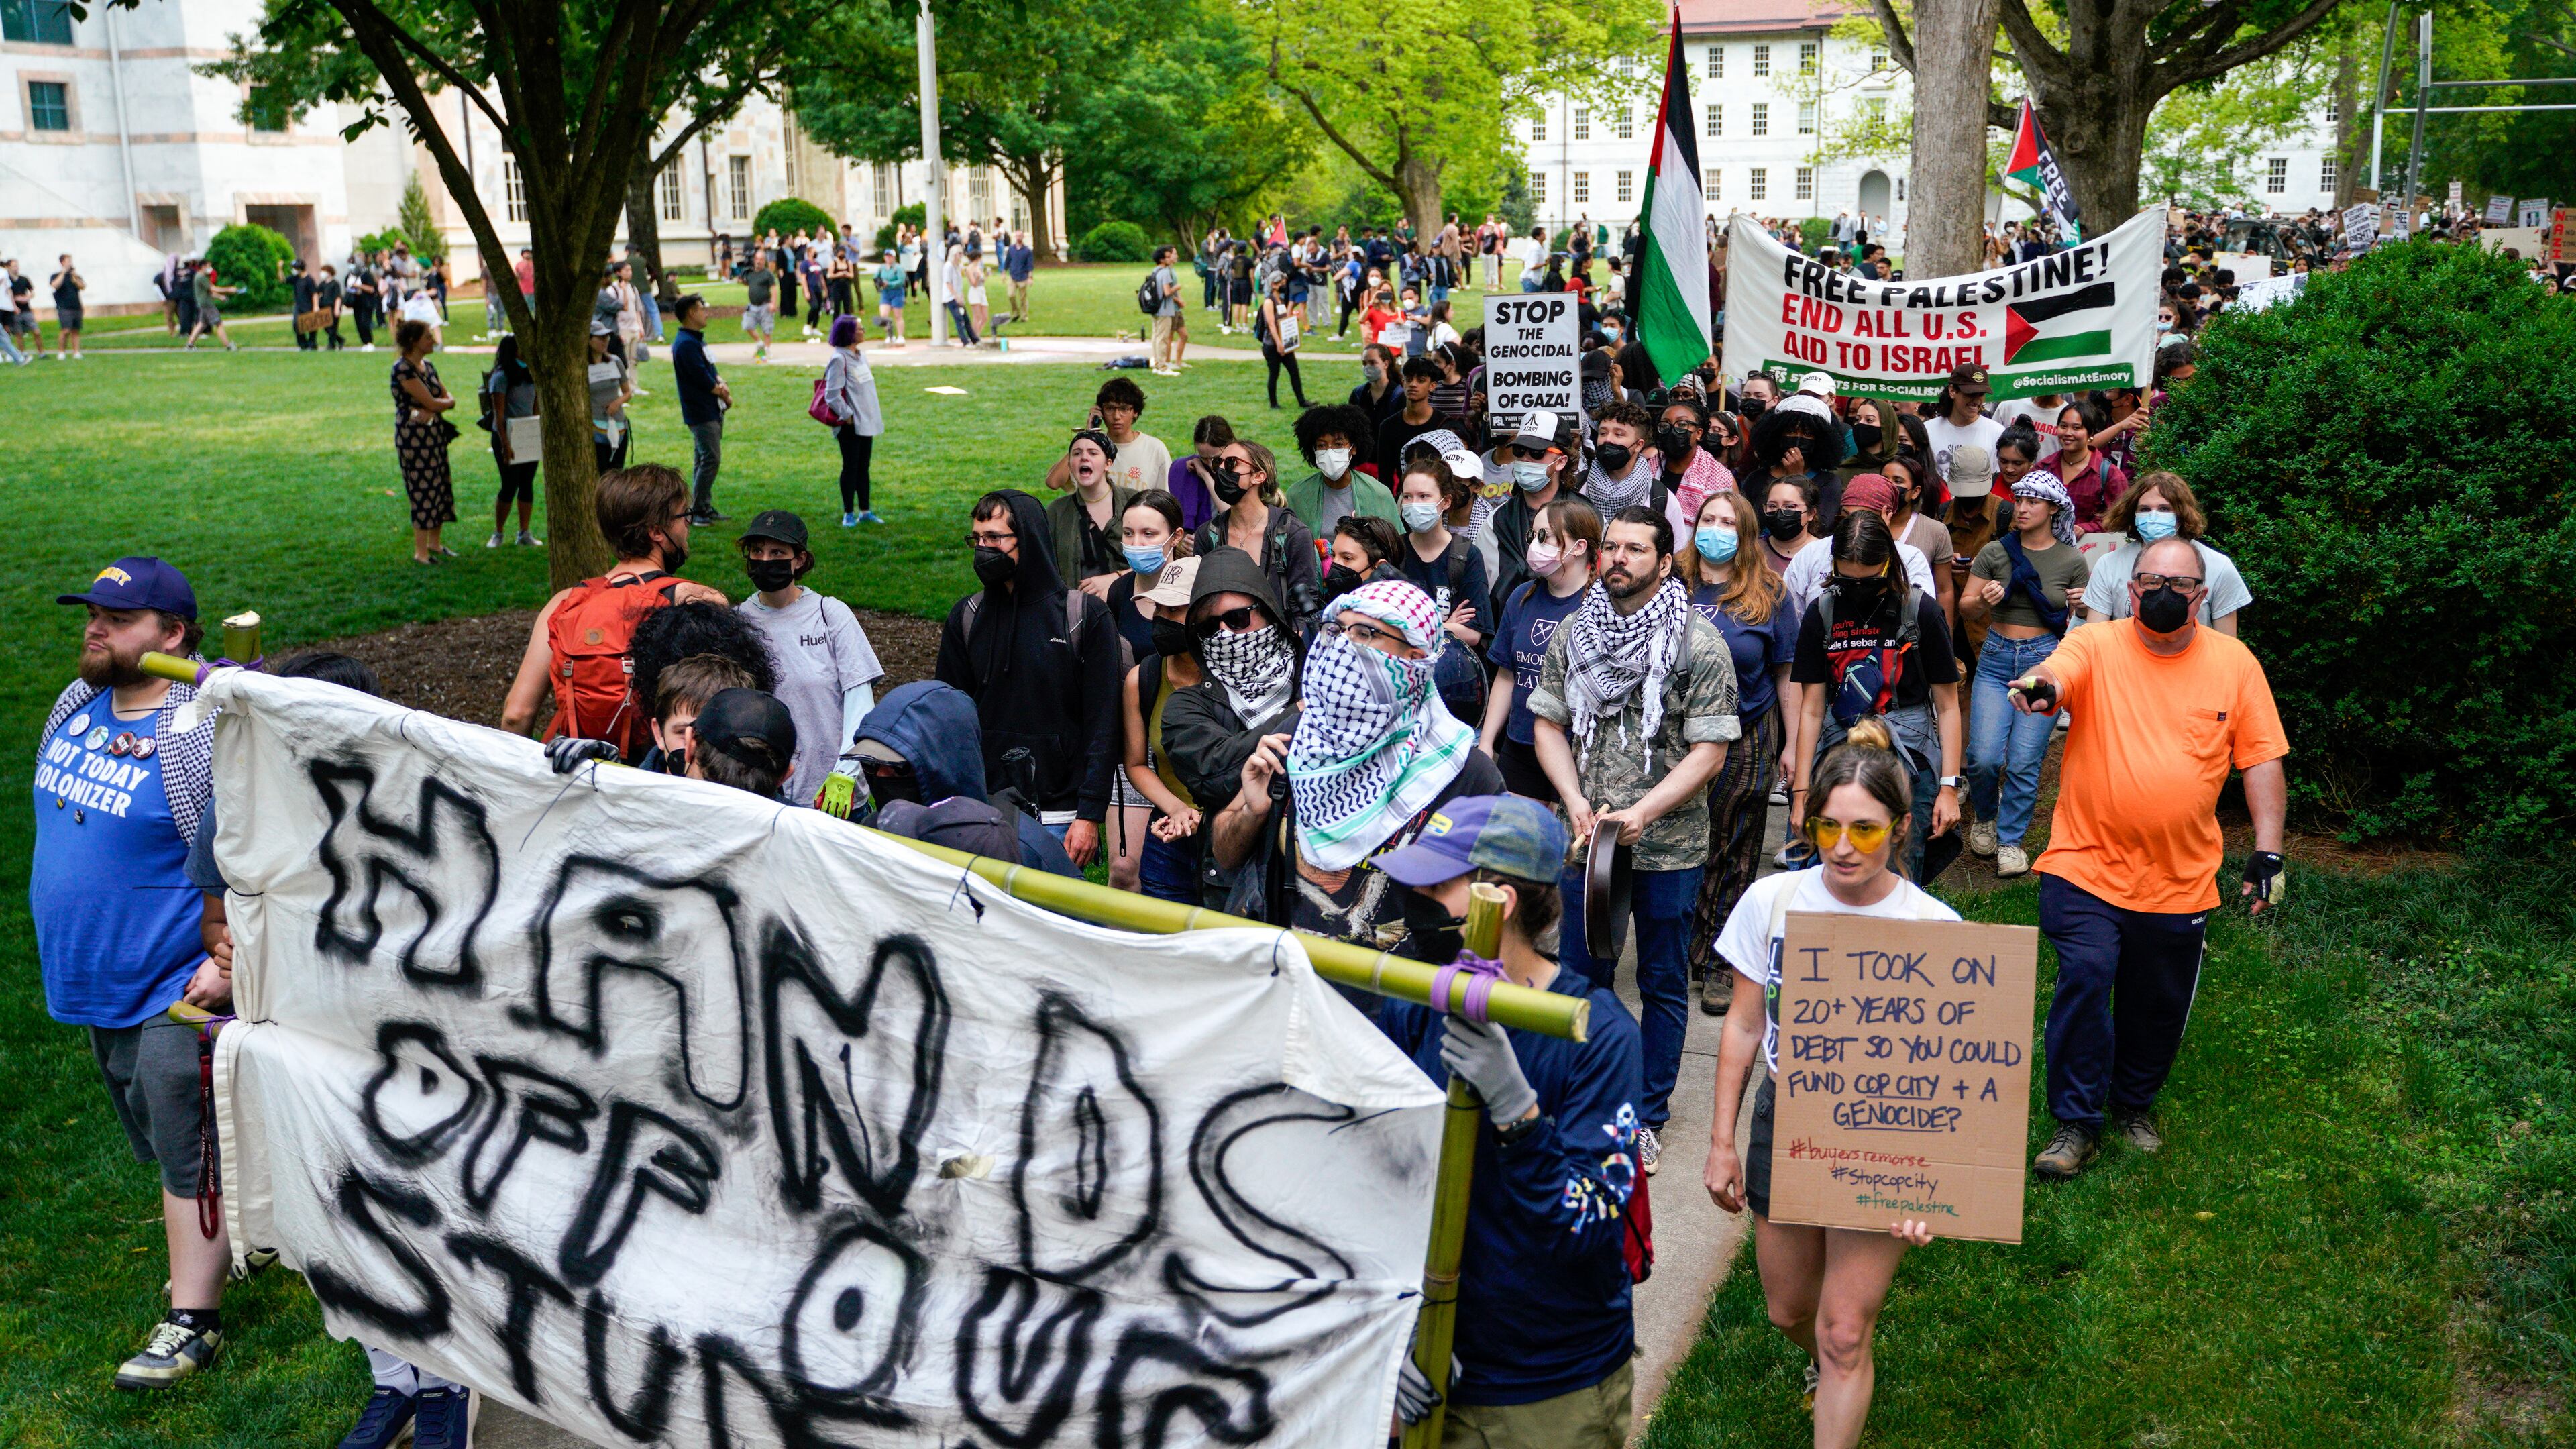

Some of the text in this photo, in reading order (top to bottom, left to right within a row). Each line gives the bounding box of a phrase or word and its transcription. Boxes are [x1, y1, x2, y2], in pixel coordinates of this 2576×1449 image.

[2037, 150, 2070, 211] FREE
[1784, 243, 2109, 307] FREE PALESTINE!
[1495, 301, 1565, 325] STOP
[1782, 292, 1987, 340] END ALL U.S.
[1518, 327, 1544, 340] THE
[1491, 344, 1573, 358] GENOCIDAL
[1783, 331, 1989, 373] AID TO ISRAEL
[1493, 370, 1573, 387] BOMBING
[1852, 382, 1877, 392] FOR
[1879, 384, 1945, 396] SOCIALISM
[2013, 371, 2130, 389] @SocialismAtEmory
[1498, 393, 1570, 408] OF GAZA!
[800, 632, 827, 647] Huel
[45, 737, 82, 768] NOT
[78, 751, 150, 791] TODAY
[1799, 947, 1995, 987] I TOOK ON
[1793, 996, 1975, 1025] 20+ YEARS OF
[310, 758, 1355, 1329] HANDS
[1791, 1034, 2021, 1067] DEBT SO YOU COULD
[1788, 1070, 1845, 1098] FUND
[1854, 1073, 1890, 1097] COP
[1896, 1075, 1940, 1099] CITY
[1980, 1077, 1998, 1102] A
[1833, 1100, 1962, 1133] GENOCIDE?
[362, 1018, 722, 1285] OFF
[1856, 1191, 1960, 1217] #freepalestine
